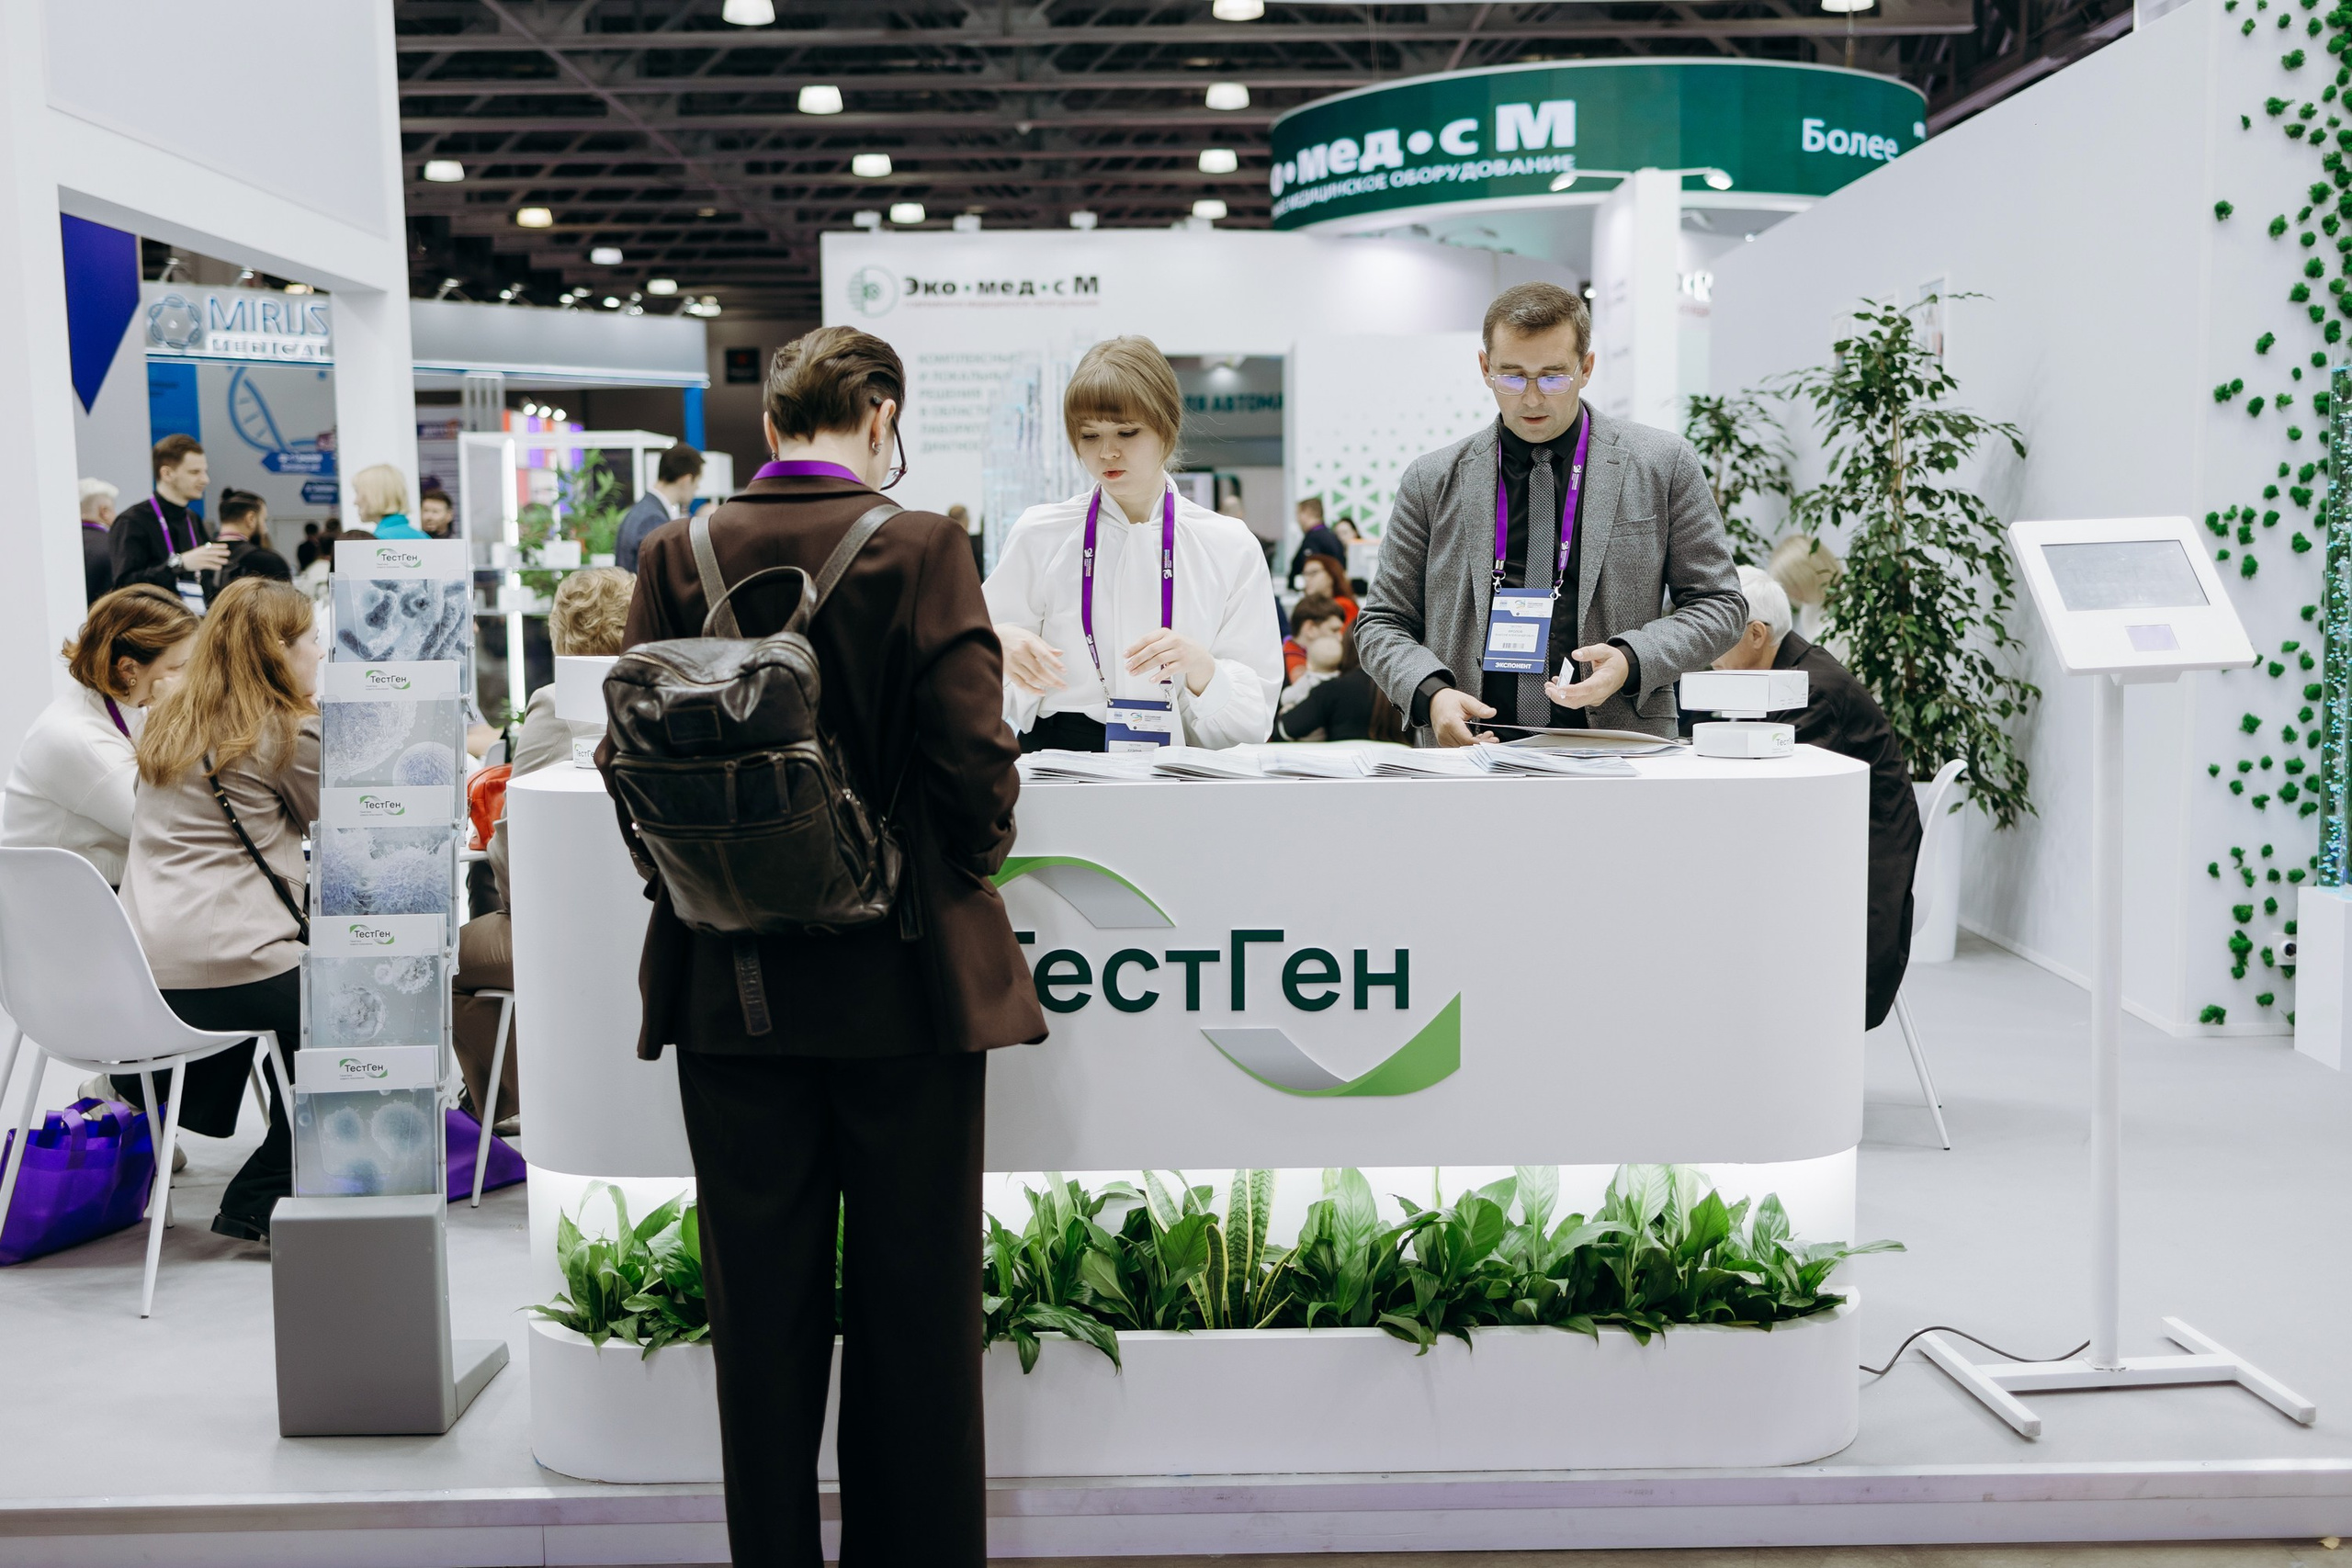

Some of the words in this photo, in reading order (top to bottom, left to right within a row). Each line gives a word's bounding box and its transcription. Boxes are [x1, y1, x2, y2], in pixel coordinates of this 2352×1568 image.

[1802, 118, 1899, 162] Более
[1389, 154, 1577, 188] ОБОРУДОВАНИЕ
[209, 298, 330, 336] MIRUS
[381, 553, 418, 561] ТестГен
[1495, 661, 1532, 670] ЭКСПОНЕНТ
[370, 675, 407, 683] ТестГен
[364, 800, 401, 809] ТестГен
[354, 930, 390, 938] ТестГен
[345, 1063, 384, 1073] ТестГен
